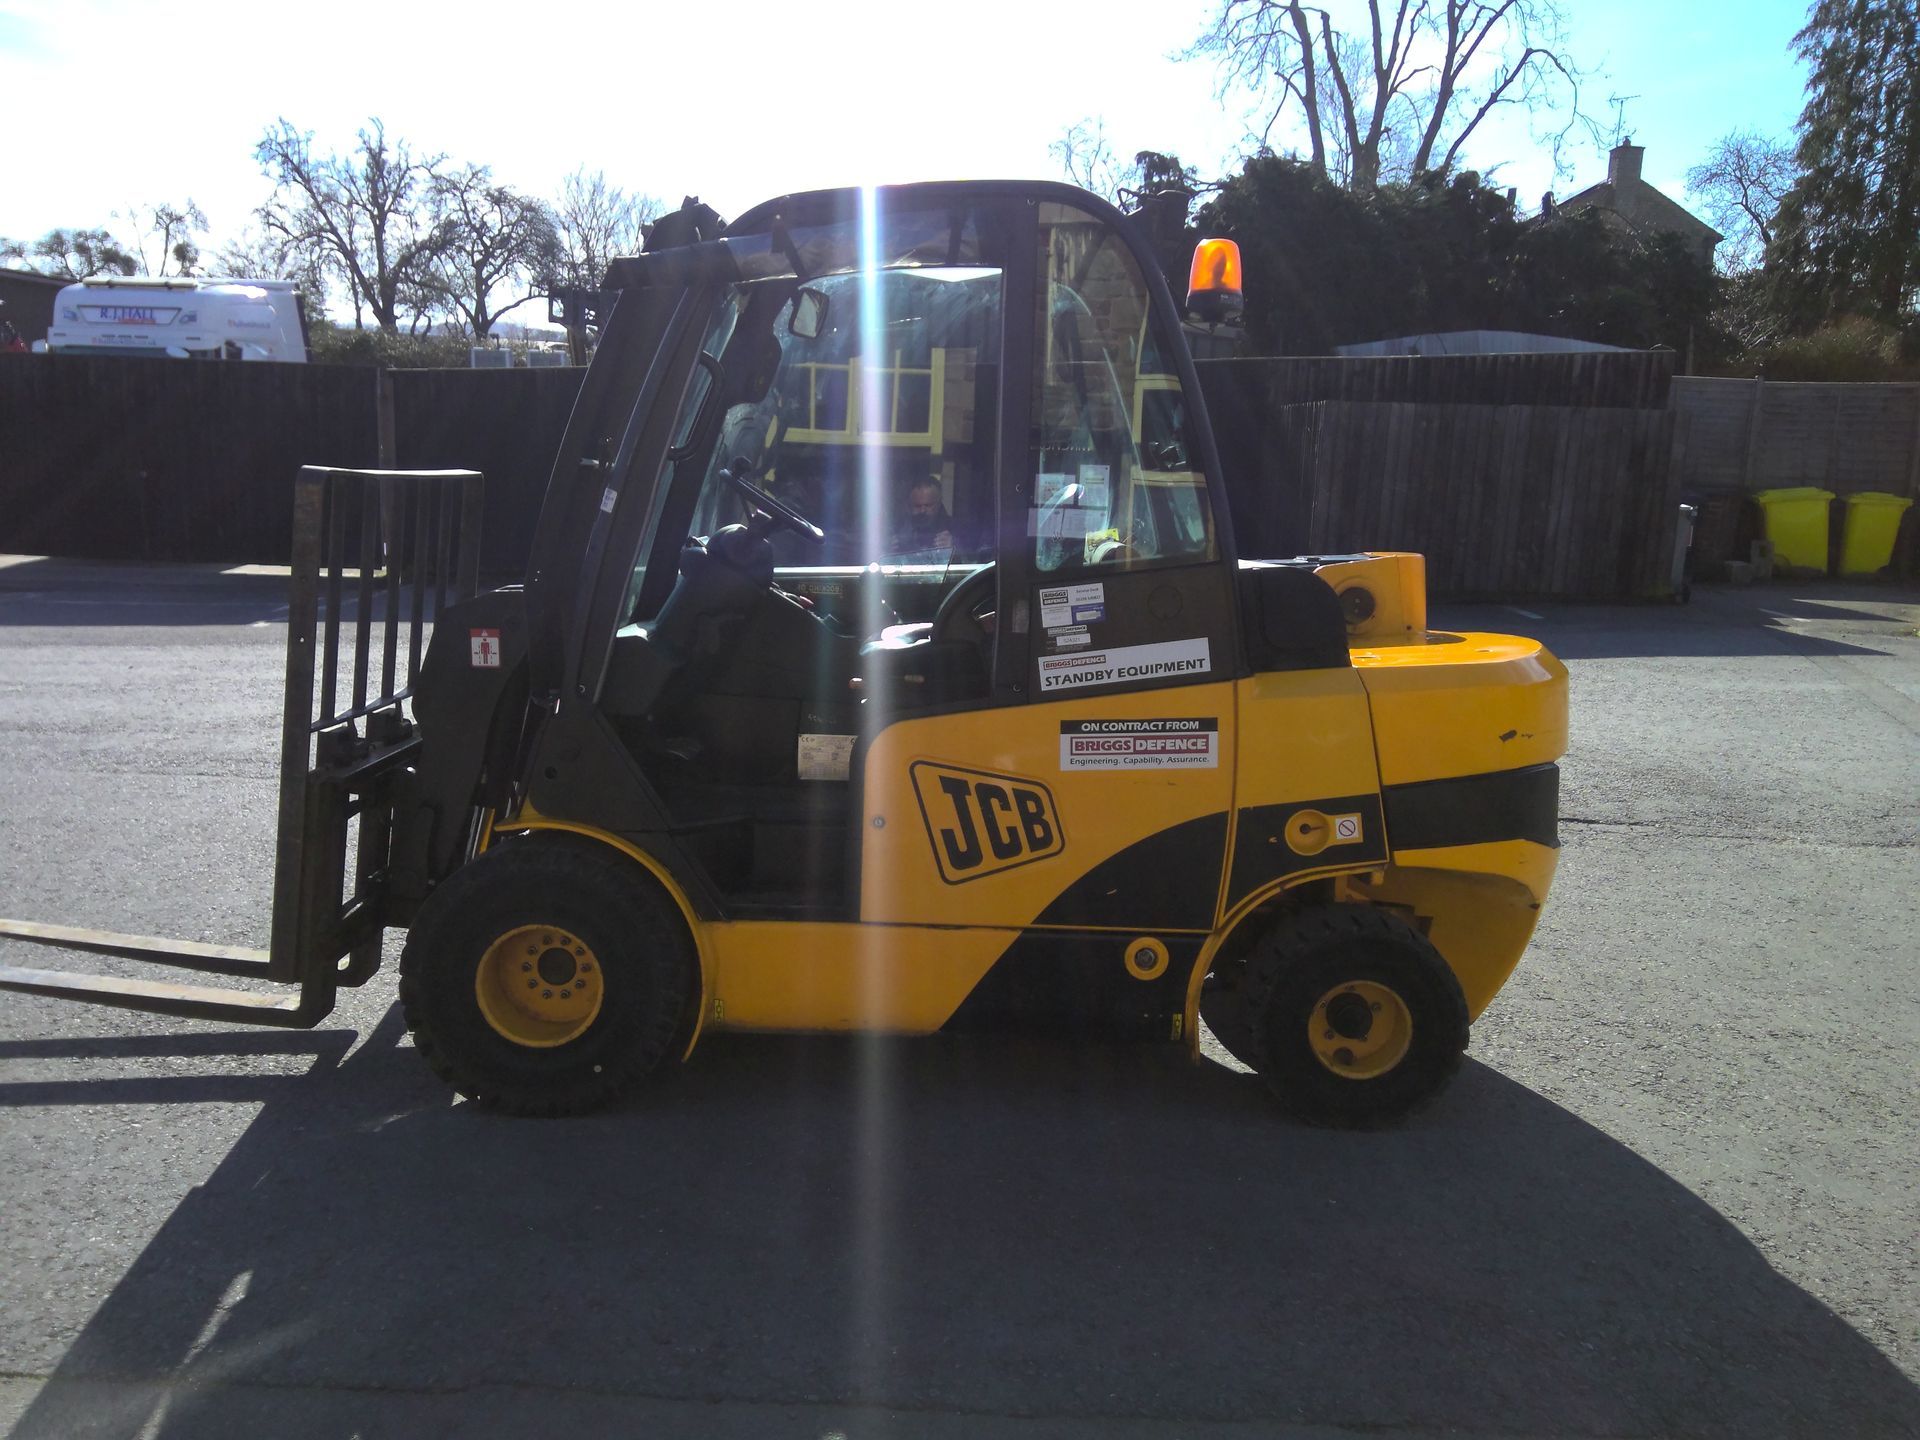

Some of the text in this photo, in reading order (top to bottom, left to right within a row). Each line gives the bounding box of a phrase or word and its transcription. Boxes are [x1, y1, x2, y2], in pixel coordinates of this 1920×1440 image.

[1045, 656, 1106, 669] BRIGGS DEFENCE
[1045, 658, 1206, 687] STANDBY EQUIPMENT
[1081, 720, 1199, 732] ON CONTRACT FROM
[1074, 738, 1207, 752] BRIGGS DEFENCE
[1070, 756, 1210, 767] Engineering. Capability. Assurance.
[938, 774, 1054, 871] JCB
